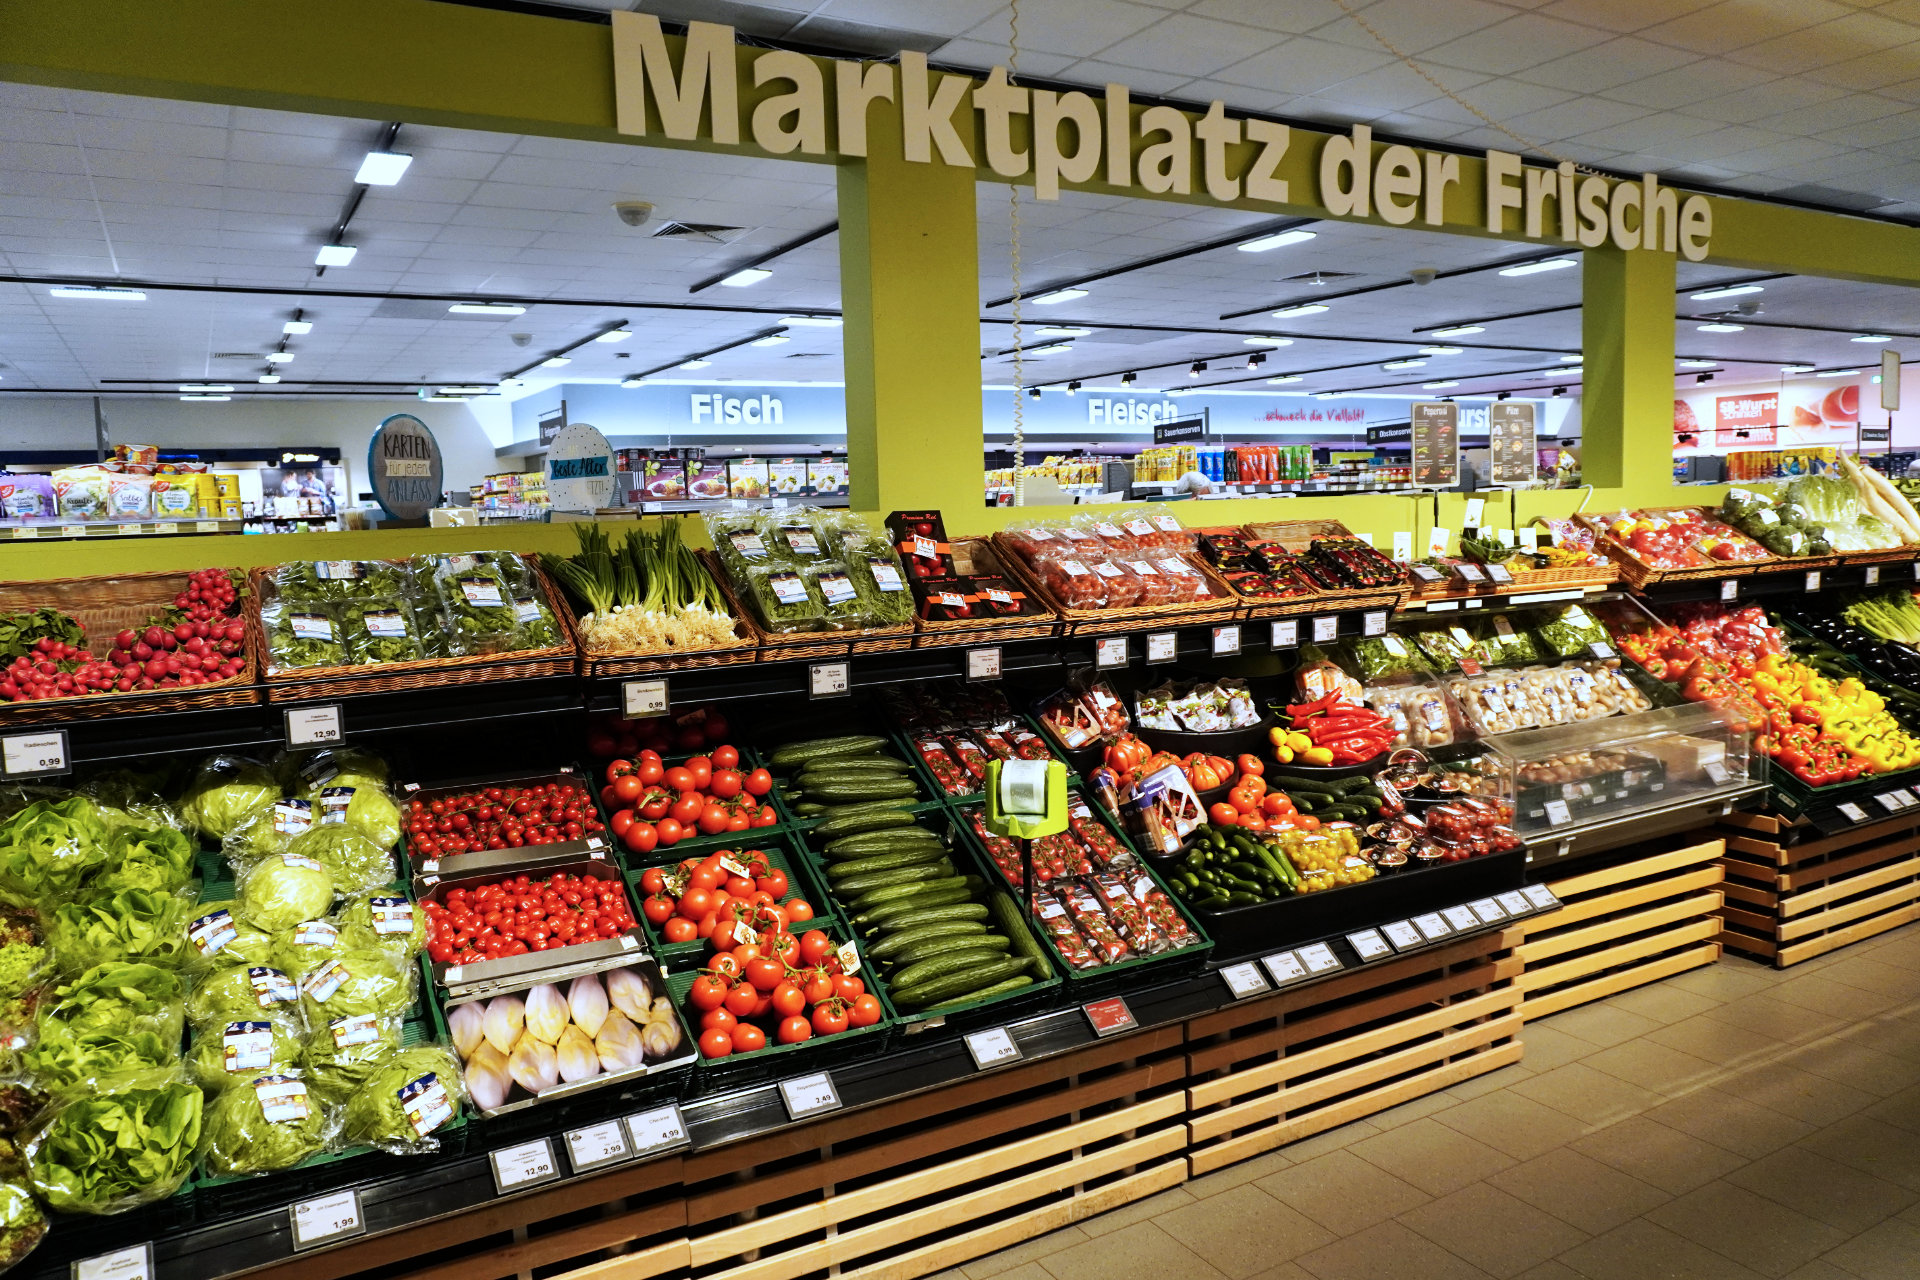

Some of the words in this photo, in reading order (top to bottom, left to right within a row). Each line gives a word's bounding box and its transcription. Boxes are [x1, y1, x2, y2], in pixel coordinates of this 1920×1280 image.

[611, 10, 1290, 202] Marktplatz
[1319, 123, 1460, 225] der
[1485, 148, 1713, 263] Frische
[690, 393, 784, 425] Fisch
[1087, 398, 1179, 425] Fleisch
[1309, 409, 1324, 423] die
[1458, 405, 1490, 429] urst
[1379, 427, 1412, 439] Obstkonserve
[383, 433, 431, 458] KARTEN
[389, 460, 402, 475] für
[402, 461, 428, 478] jeden
[553, 459, 578, 477] beste
[387, 479, 432, 502] ANLASS
[832, 682, 845, 691] 1,49
[648, 701, 663, 710] 0,99
[314, 729, 336, 740] 12,90
[39, 757, 61, 768] 0,99
[815, 1094, 832, 1104] 2,49
[661, 1129, 680, 1139] 4,99
[602, 1144, 621, 1156] 2,99
[524, 1164, 549, 1177] 12,90
[332, 1217, 355, 1230] 1,99
